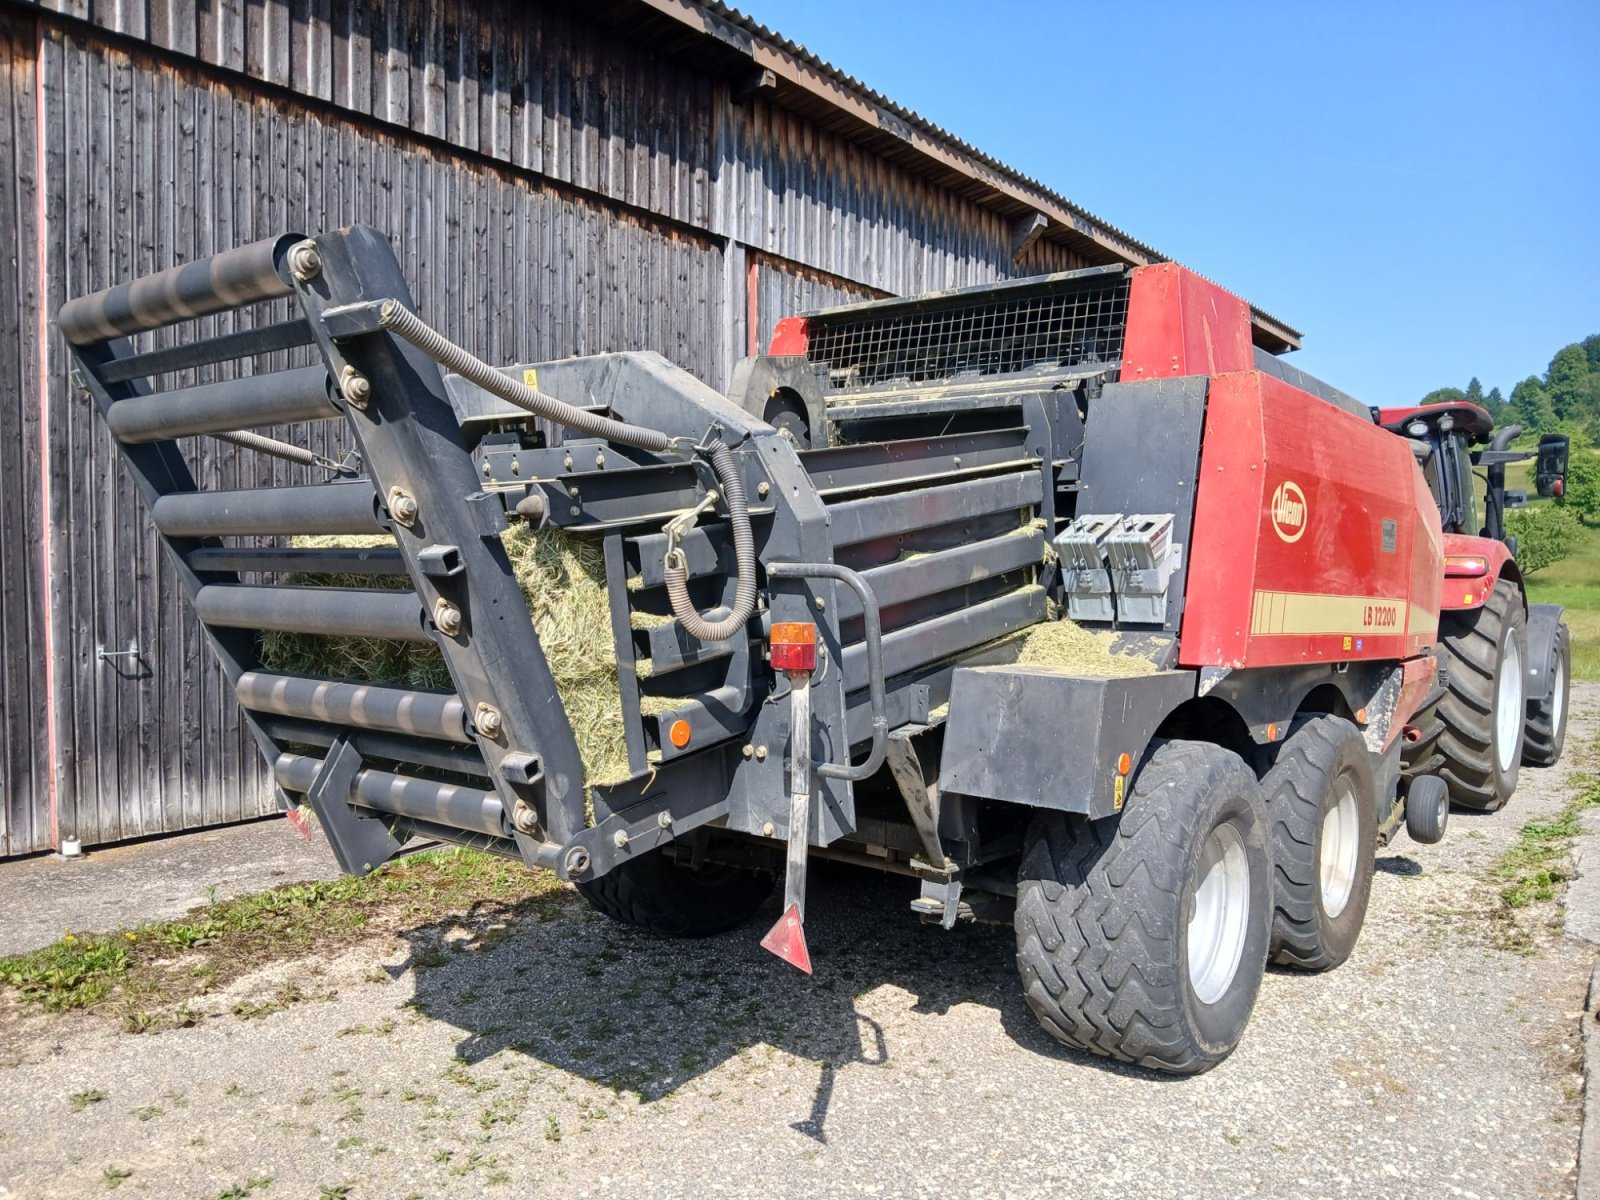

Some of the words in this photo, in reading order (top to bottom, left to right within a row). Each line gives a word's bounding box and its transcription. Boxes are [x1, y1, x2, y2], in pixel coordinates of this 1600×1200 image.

[1276, 483, 1304, 528] Vicon
[1363, 605, 1373, 626] LB
[1375, 606, 1397, 627] 12200
